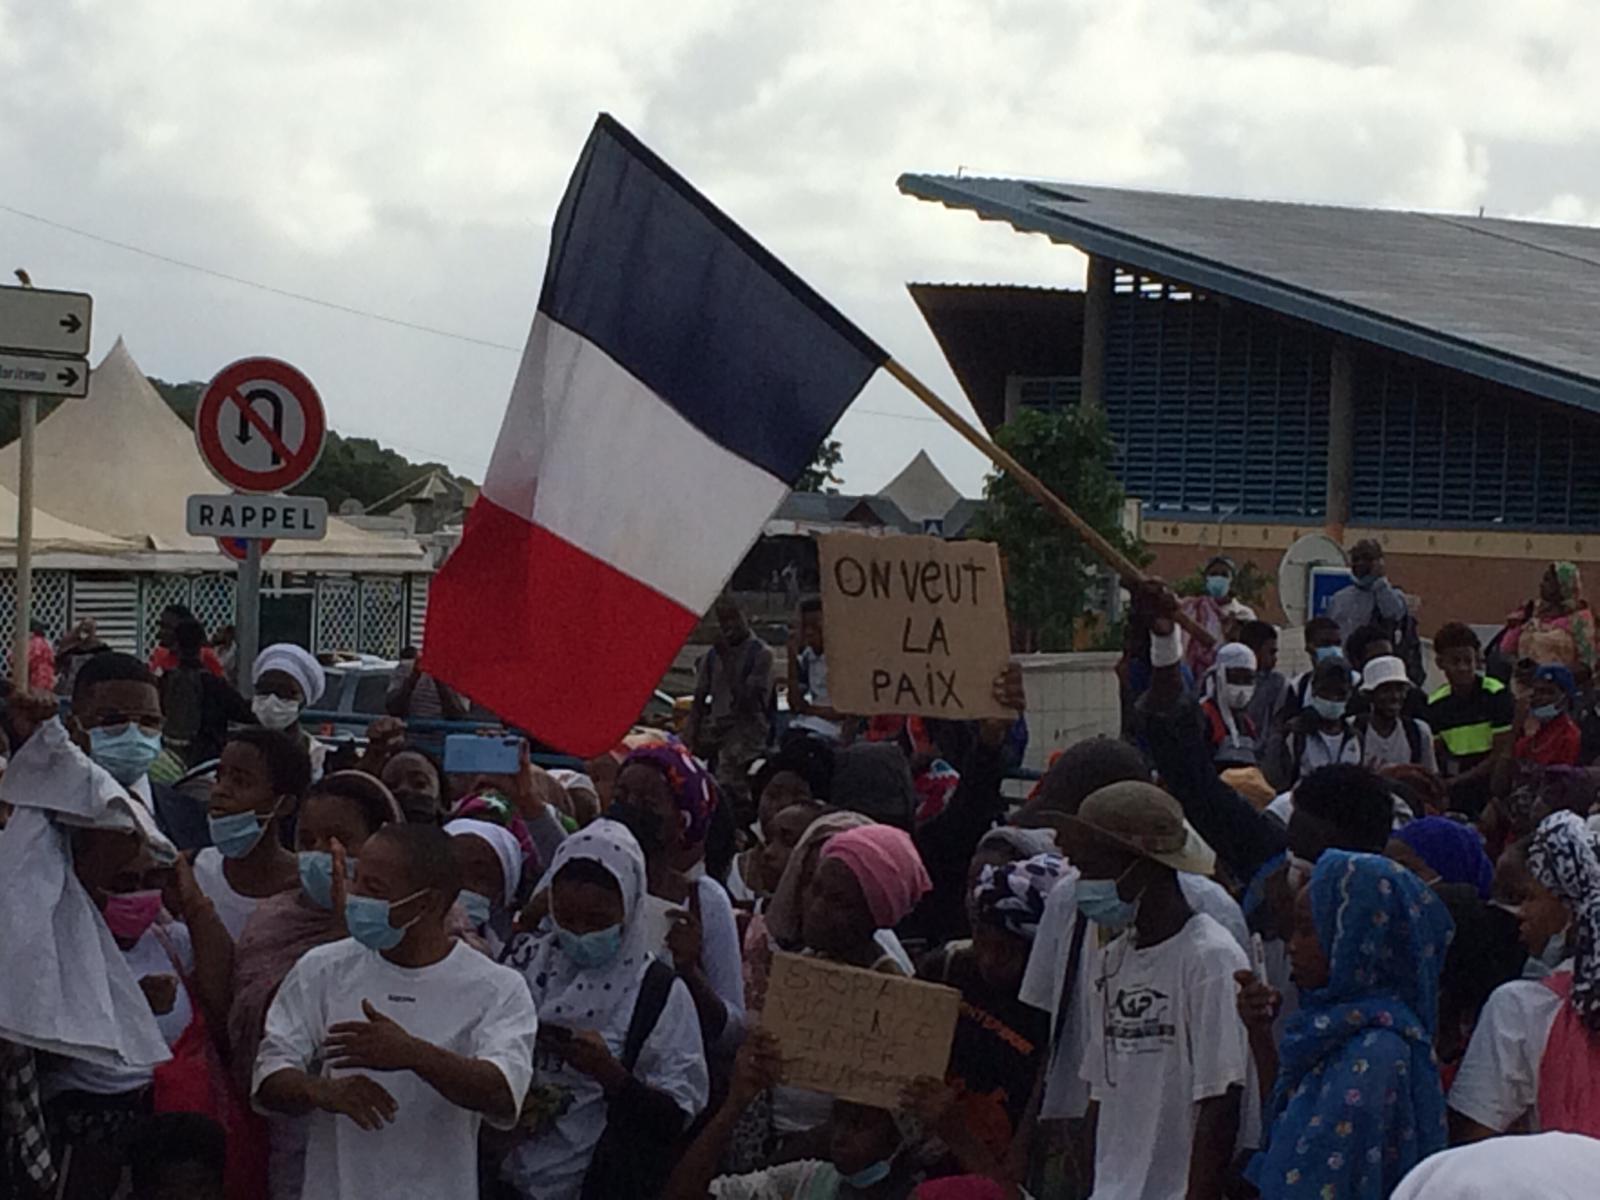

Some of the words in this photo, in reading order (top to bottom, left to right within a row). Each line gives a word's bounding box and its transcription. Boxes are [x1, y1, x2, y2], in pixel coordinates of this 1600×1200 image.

[199, 504, 316, 530] RAPPEL
[834, 556, 892, 599] ON
[902, 616, 950, 656] LA
